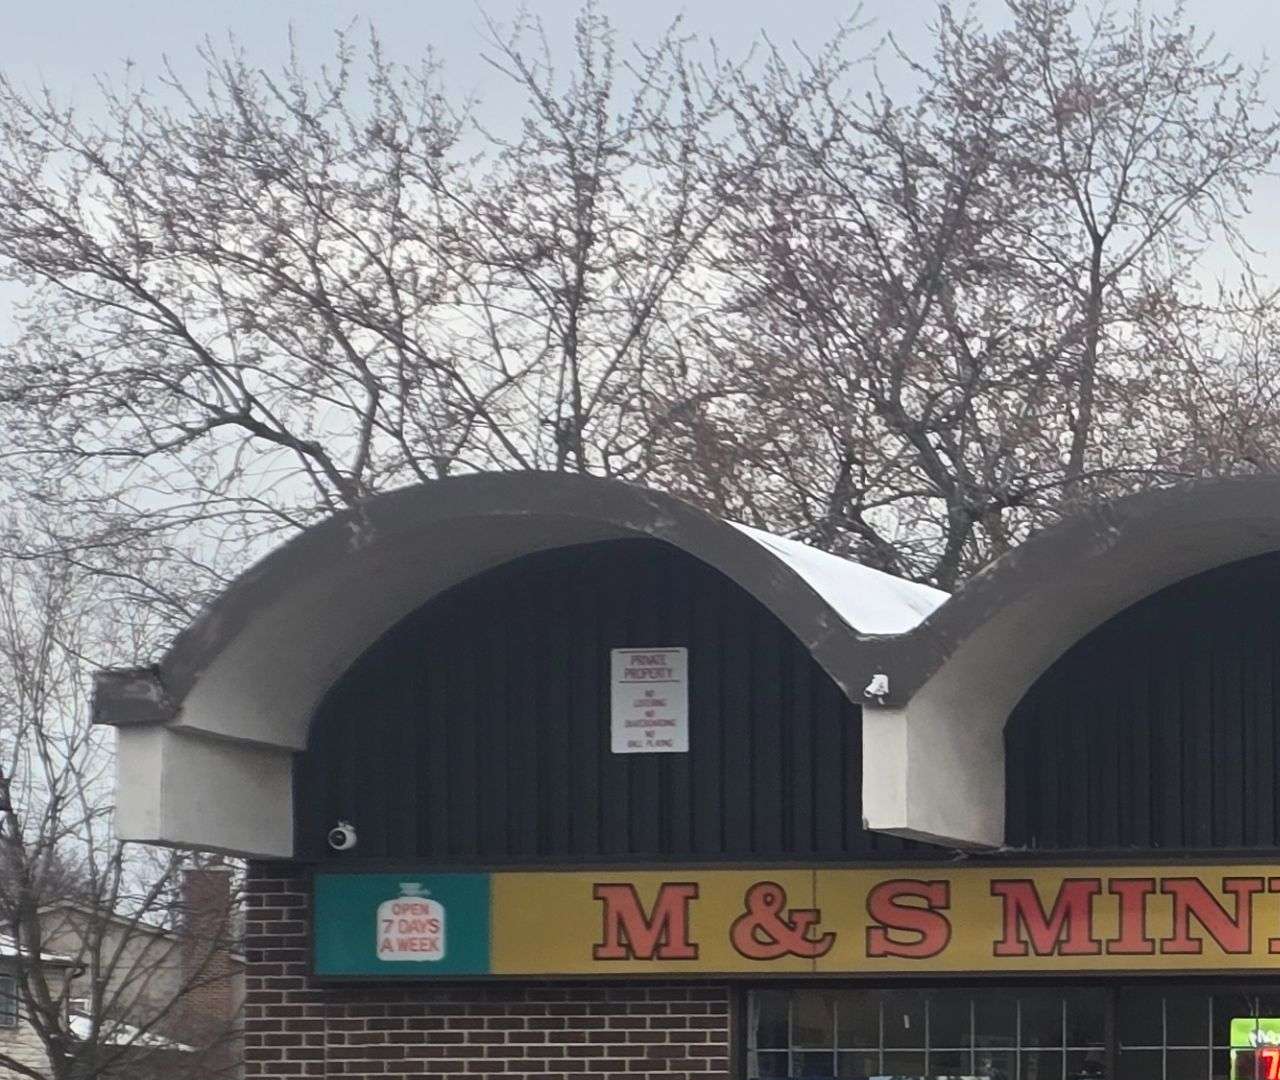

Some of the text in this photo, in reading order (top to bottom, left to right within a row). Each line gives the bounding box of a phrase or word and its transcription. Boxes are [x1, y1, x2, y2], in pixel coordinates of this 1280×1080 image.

[391, 903, 430, 915] OPEN
[382, 919, 441, 934] 7 DAYS
[593, 883, 699, 961] M
[729, 881, 836, 961] &
[866, 880, 952, 959] S
[379, 937, 441, 953] A WEEK
